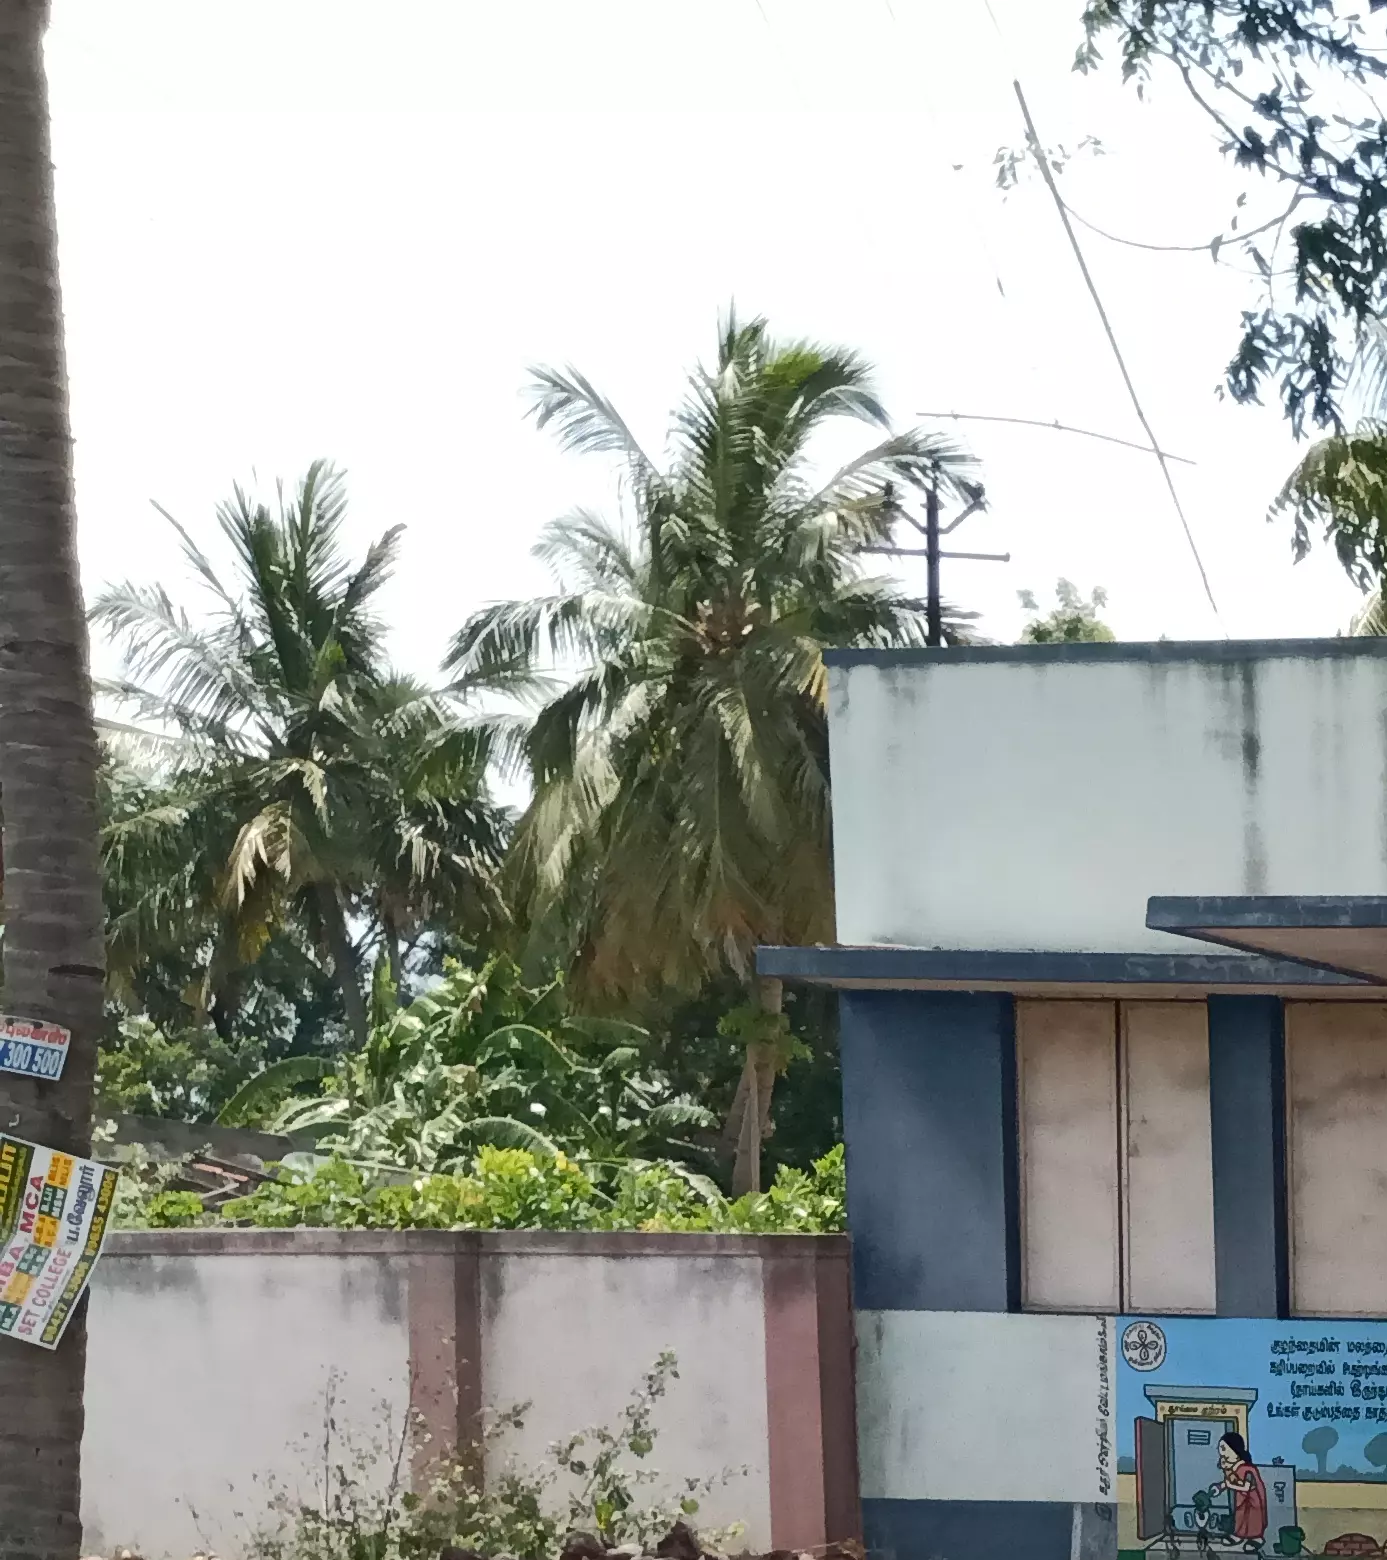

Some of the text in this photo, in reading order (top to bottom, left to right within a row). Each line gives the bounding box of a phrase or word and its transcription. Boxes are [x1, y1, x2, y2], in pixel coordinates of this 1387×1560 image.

[4, 1041, 60, 1075] 300 500
[19, 1175, 44, 1233] MCA
[17, 1309, 41, 1336] SET
[32, 1247, 72, 1308] COLLEGE
